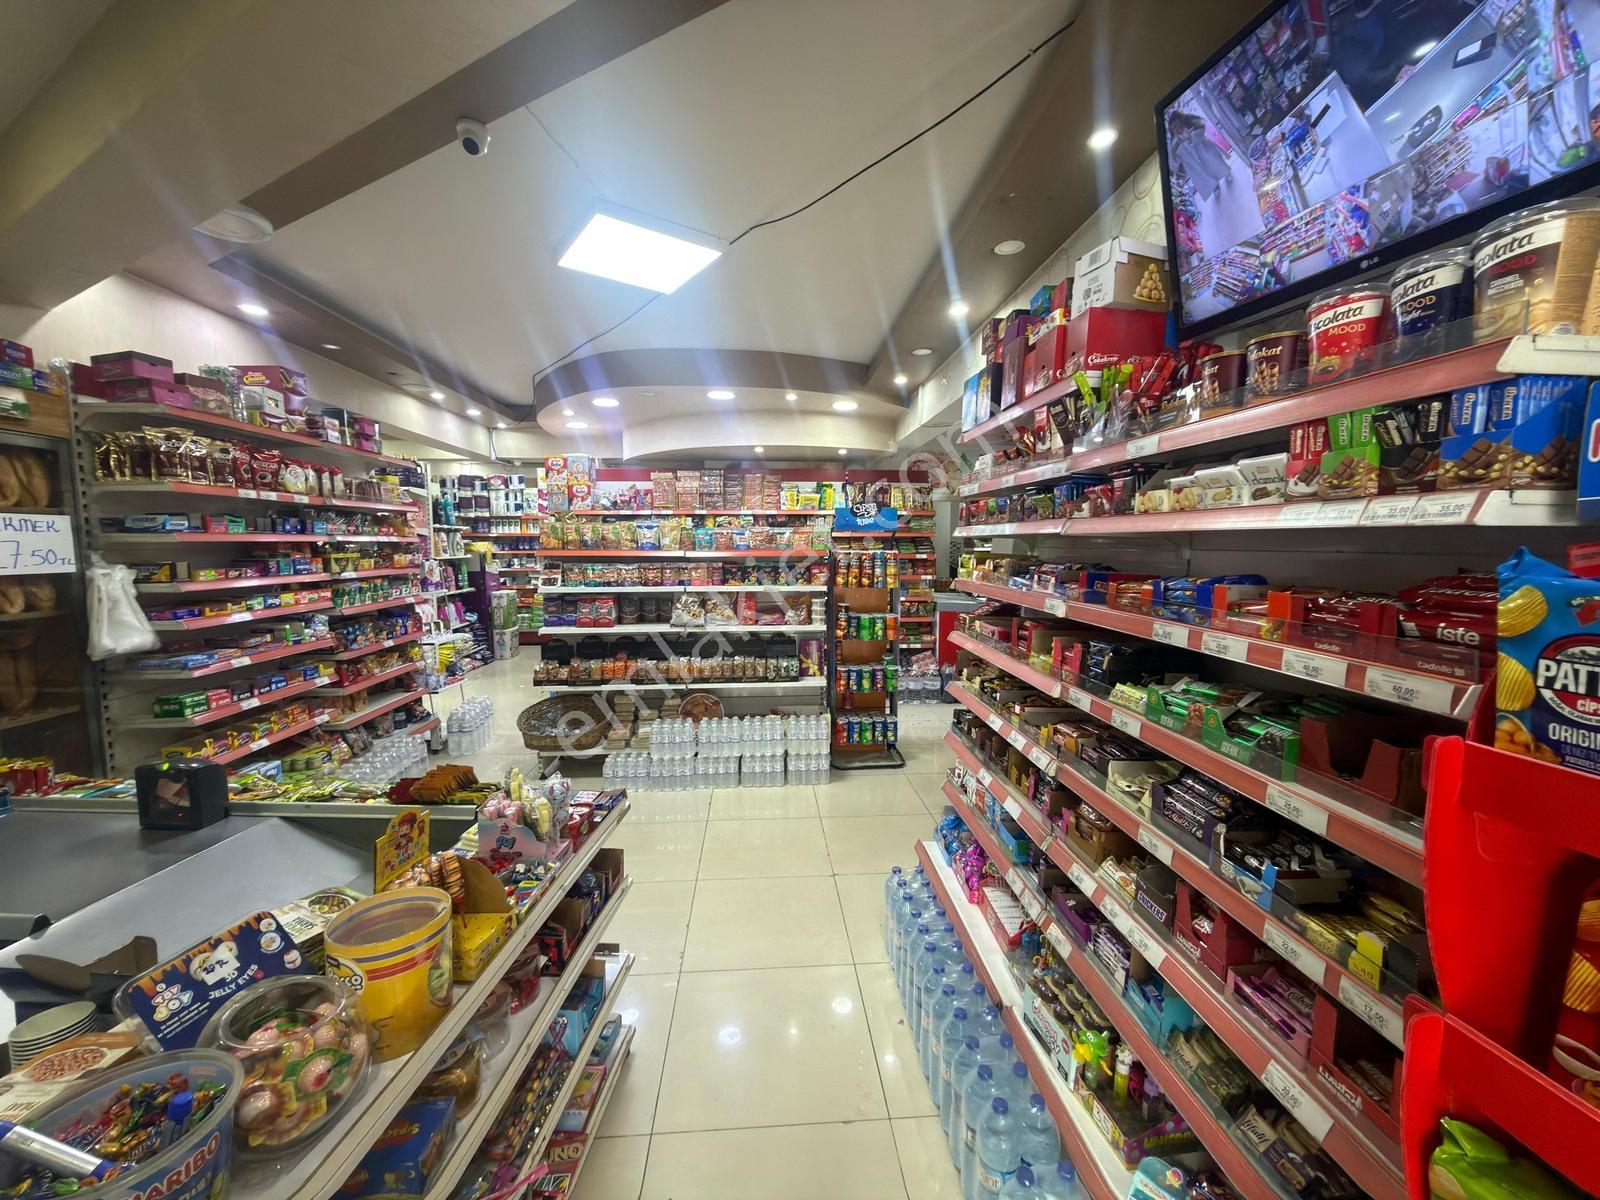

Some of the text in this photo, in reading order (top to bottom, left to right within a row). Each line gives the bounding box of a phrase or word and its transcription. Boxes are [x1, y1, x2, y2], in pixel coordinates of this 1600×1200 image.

[1328, 323, 1367, 336] MOOD
[0, 517, 61, 533] KMEK
[1138, 893, 1166, 921] SNICKERS
[208, 963, 259, 1000] JELLY EYES
